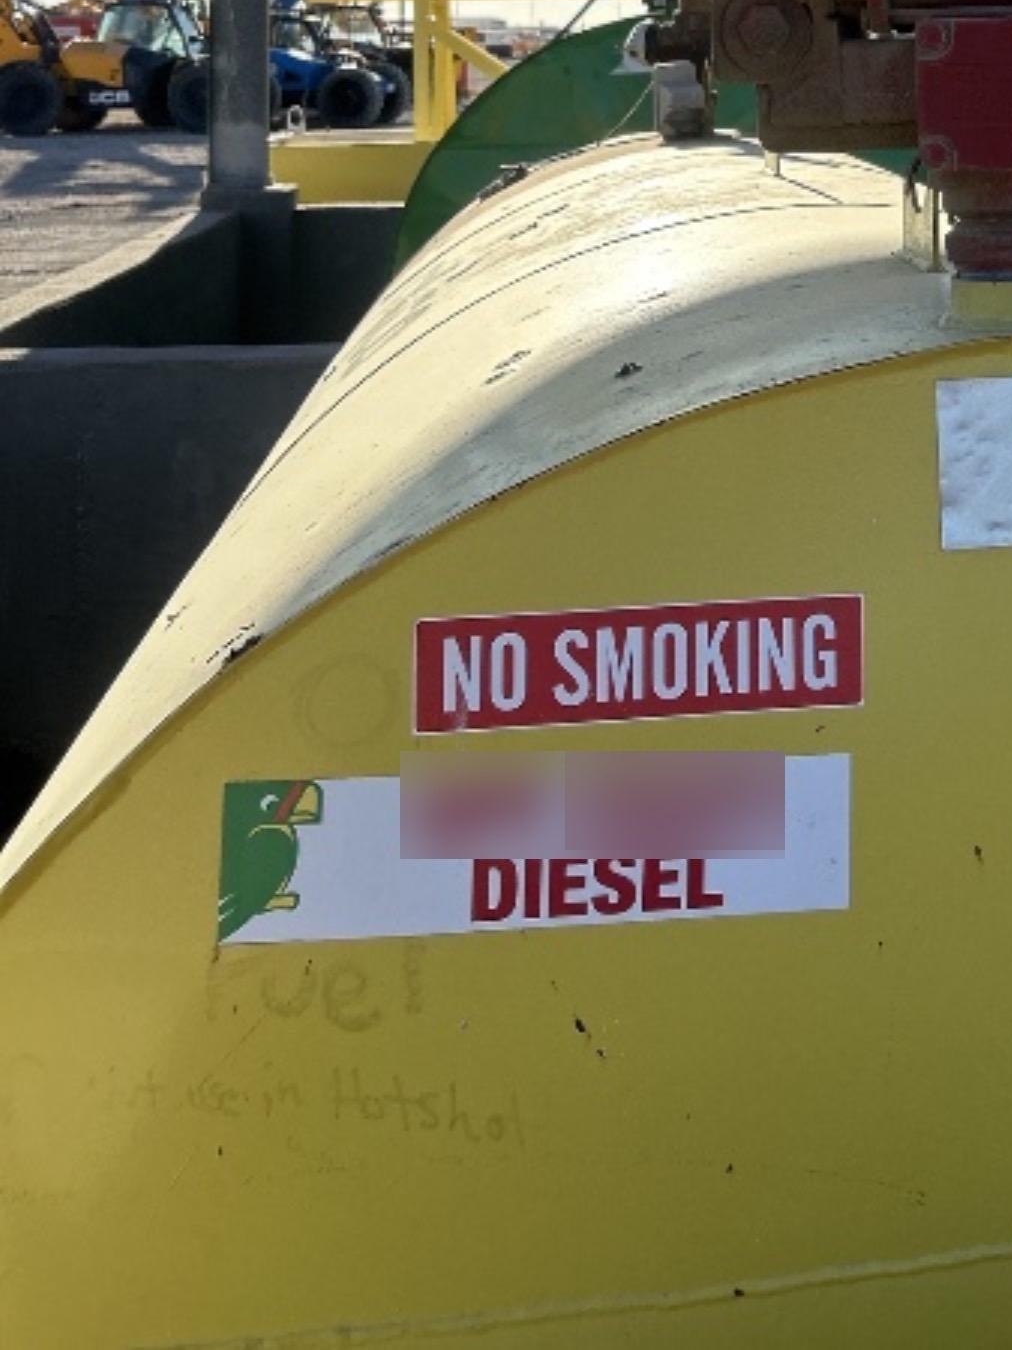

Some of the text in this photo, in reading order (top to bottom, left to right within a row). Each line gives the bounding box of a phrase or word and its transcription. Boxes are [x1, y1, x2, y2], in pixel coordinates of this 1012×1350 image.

[443, 613, 838, 713] NO SMOKING
[471, 857, 725, 923] DIESEL
